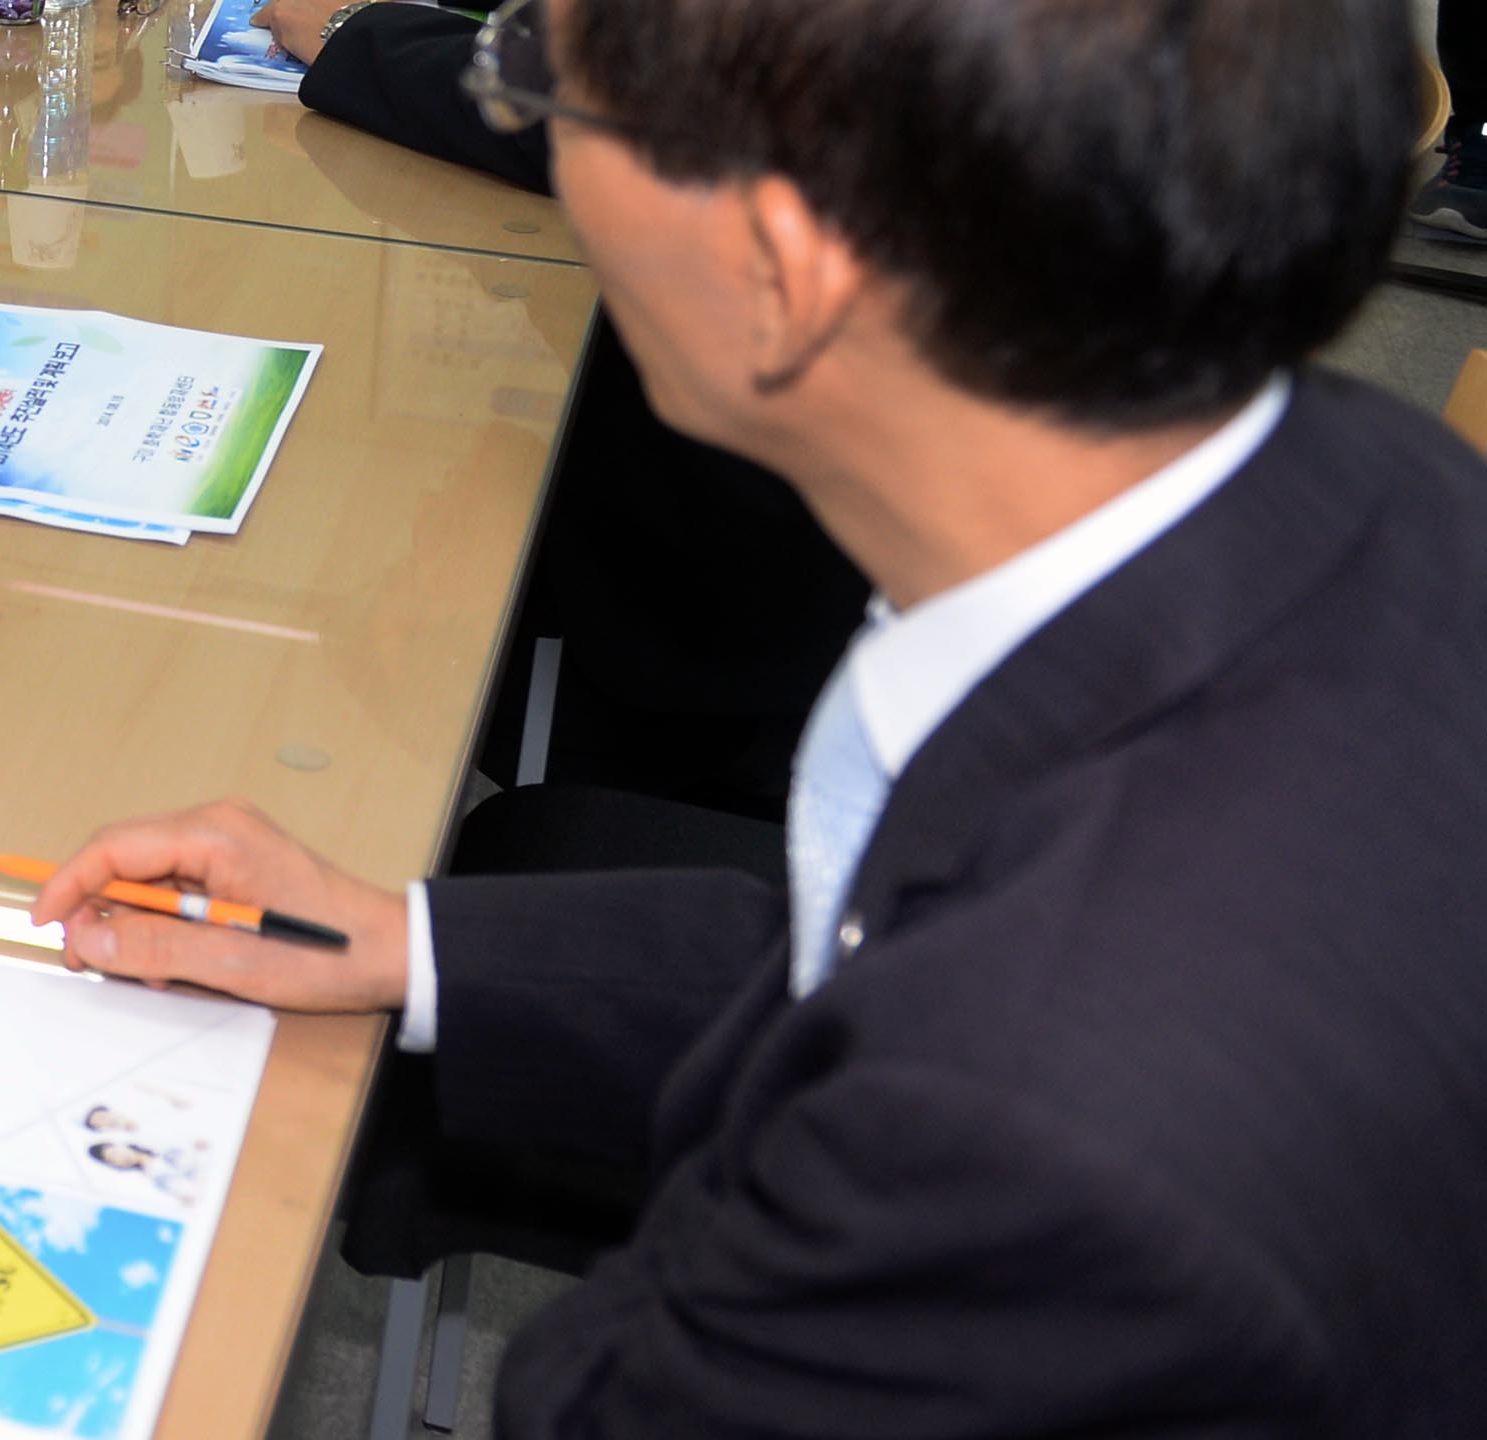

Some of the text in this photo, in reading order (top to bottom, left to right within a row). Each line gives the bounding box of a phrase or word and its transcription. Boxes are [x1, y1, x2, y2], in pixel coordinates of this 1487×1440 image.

[56, 341, 81, 362] 보고
[39, 356, 72, 379] 계획
[33, 375, 60, 394] 및
[10, 388, 54, 424] 추진실적
